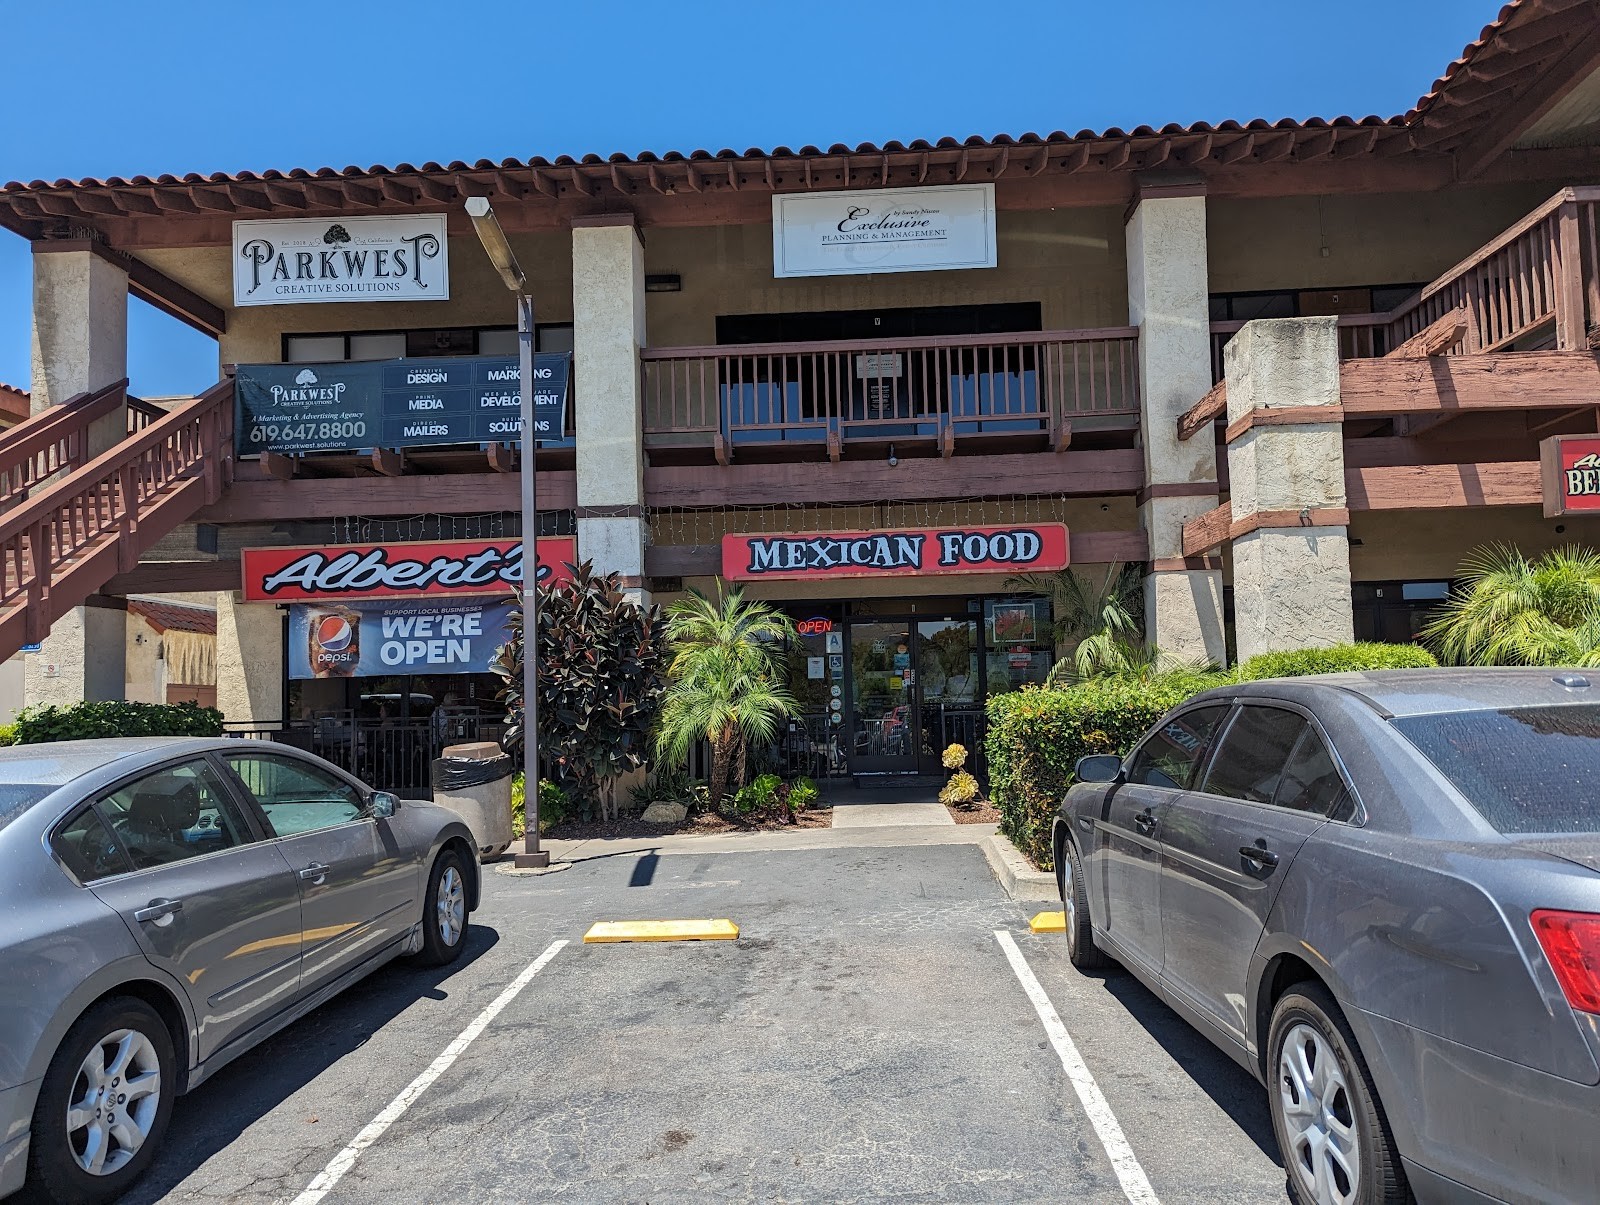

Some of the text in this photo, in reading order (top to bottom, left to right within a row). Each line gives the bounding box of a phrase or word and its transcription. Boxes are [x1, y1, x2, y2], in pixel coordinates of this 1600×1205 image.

[837, 205, 931, 233] Exclusive
[882, 230, 947, 238] MANAGEMENT
[242, 233, 440, 295] PARKWEST
[275, 282, 401, 295] CREATIVE SOLUTIONS
[407, 372, 448, 384] DESIGN
[488, 368, 552, 381] MARKNG
[270, 382, 346, 406] PARKWEST
[408, 399, 444, 410] MEDIA
[258, 414, 292, 423] Marketing
[301, 412, 338, 421] Advertising
[339, 411, 364, 420] Agency
[250, 421, 366, 443] 619.647.8800
[403, 424, 449, 437] MAILERS
[267, 441, 347, 451] www.parkwest.solutions
[750, 532, 1040, 571] MEXICAN FOOD
[381, 612, 483, 638] WE'RE
[798, 620, 832, 633] OPEN
[317, 652, 350, 664] pepsi
[380, 639, 471, 666] OPEN
